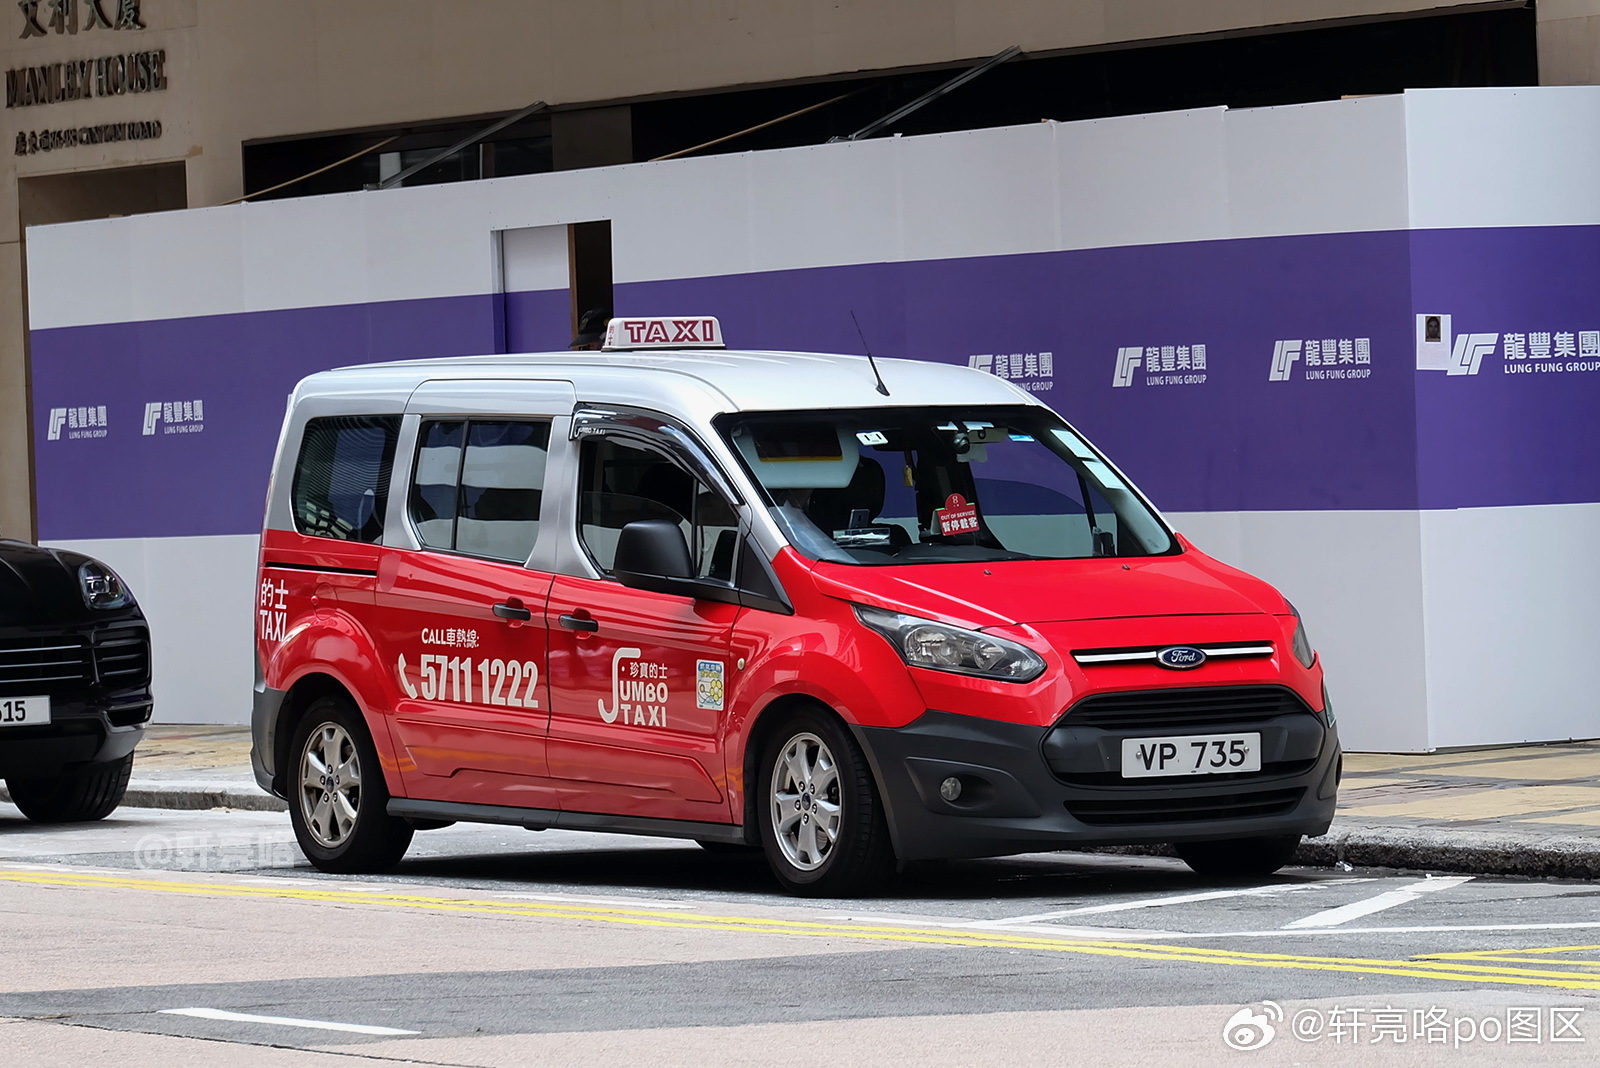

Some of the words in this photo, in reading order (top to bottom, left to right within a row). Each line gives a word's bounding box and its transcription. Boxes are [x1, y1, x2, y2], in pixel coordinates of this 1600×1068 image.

[5, 60, 93, 108] MANLEY
[95, 50, 168, 98] HOUSE
[127, 120, 162, 140] ROAD
[624, 320, 714, 343] TAXI
[1305, 338, 1371, 366] 龍豐集團
[1503, 330, 1600, 360] 龍豐集團
[995, 352, 1054, 379] 龍豐集團
[1146, 344, 1207, 373] 龍豐集團
[1504, 363, 1533, 374] LUNG
[1535, 363, 1563, 373] FUNG
[1566, 361, 1600, 372] GROUP
[1032, 381, 1054, 391] GROUP
[1147, 376, 1164, 386] LUNG
[1166, 375, 1183, 385] FUNG
[1184, 374, 1207, 385] GROUP
[1306, 371, 1325, 380] LUNG
[1327, 370, 1345, 379] FUNG
[1347, 369, 1371, 379] GROUP
[68, 405, 108, 428] 龍豐集團
[163, 400, 204, 423] 龍豐集團
[69, 430, 80, 439] LUNG
[81, 430, 92, 438] FUNG
[93, 429, 108, 438] GROUP
[164, 426, 176, 434] LUNG
[176, 425, 188, 434] FUNG
[189, 424, 204, 433] GROUP
[957, 510, 975, 518] SERVICE
[260, 577, 289, 609] 的士
[260, 609, 287, 642] TAXI
[1170, 650, 1197, 663] Ford
[420, 653, 474, 702] 5711
[477, 658, 539, 709] 1222
[0, 700, 26, 722] 15
[620, 703, 667, 727] TAXI
[1139, 743, 1177, 770] VP
[1190, 740, 1246, 769] 735
